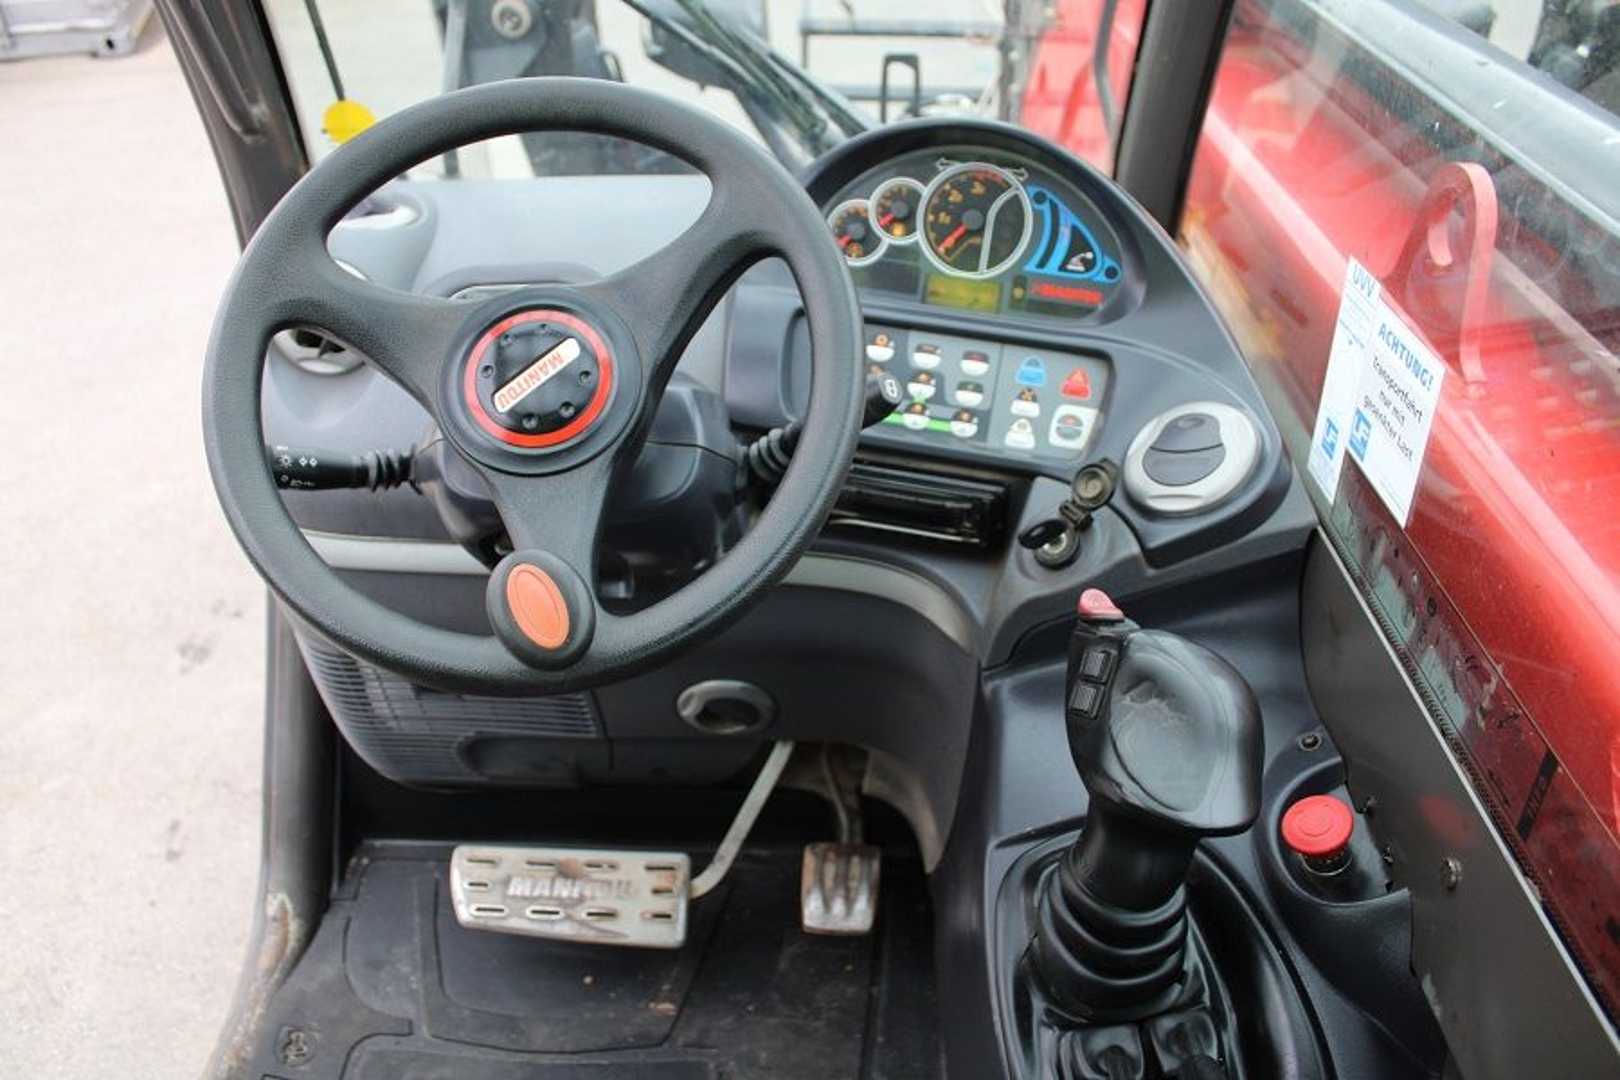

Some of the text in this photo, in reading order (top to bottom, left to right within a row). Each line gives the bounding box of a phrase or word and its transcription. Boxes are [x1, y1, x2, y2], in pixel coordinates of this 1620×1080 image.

[1352, 264, 1376, 297] UVV
[498, 350, 564, 408] MANITOU
[1378, 323, 1434, 391] ACHTUNG!
